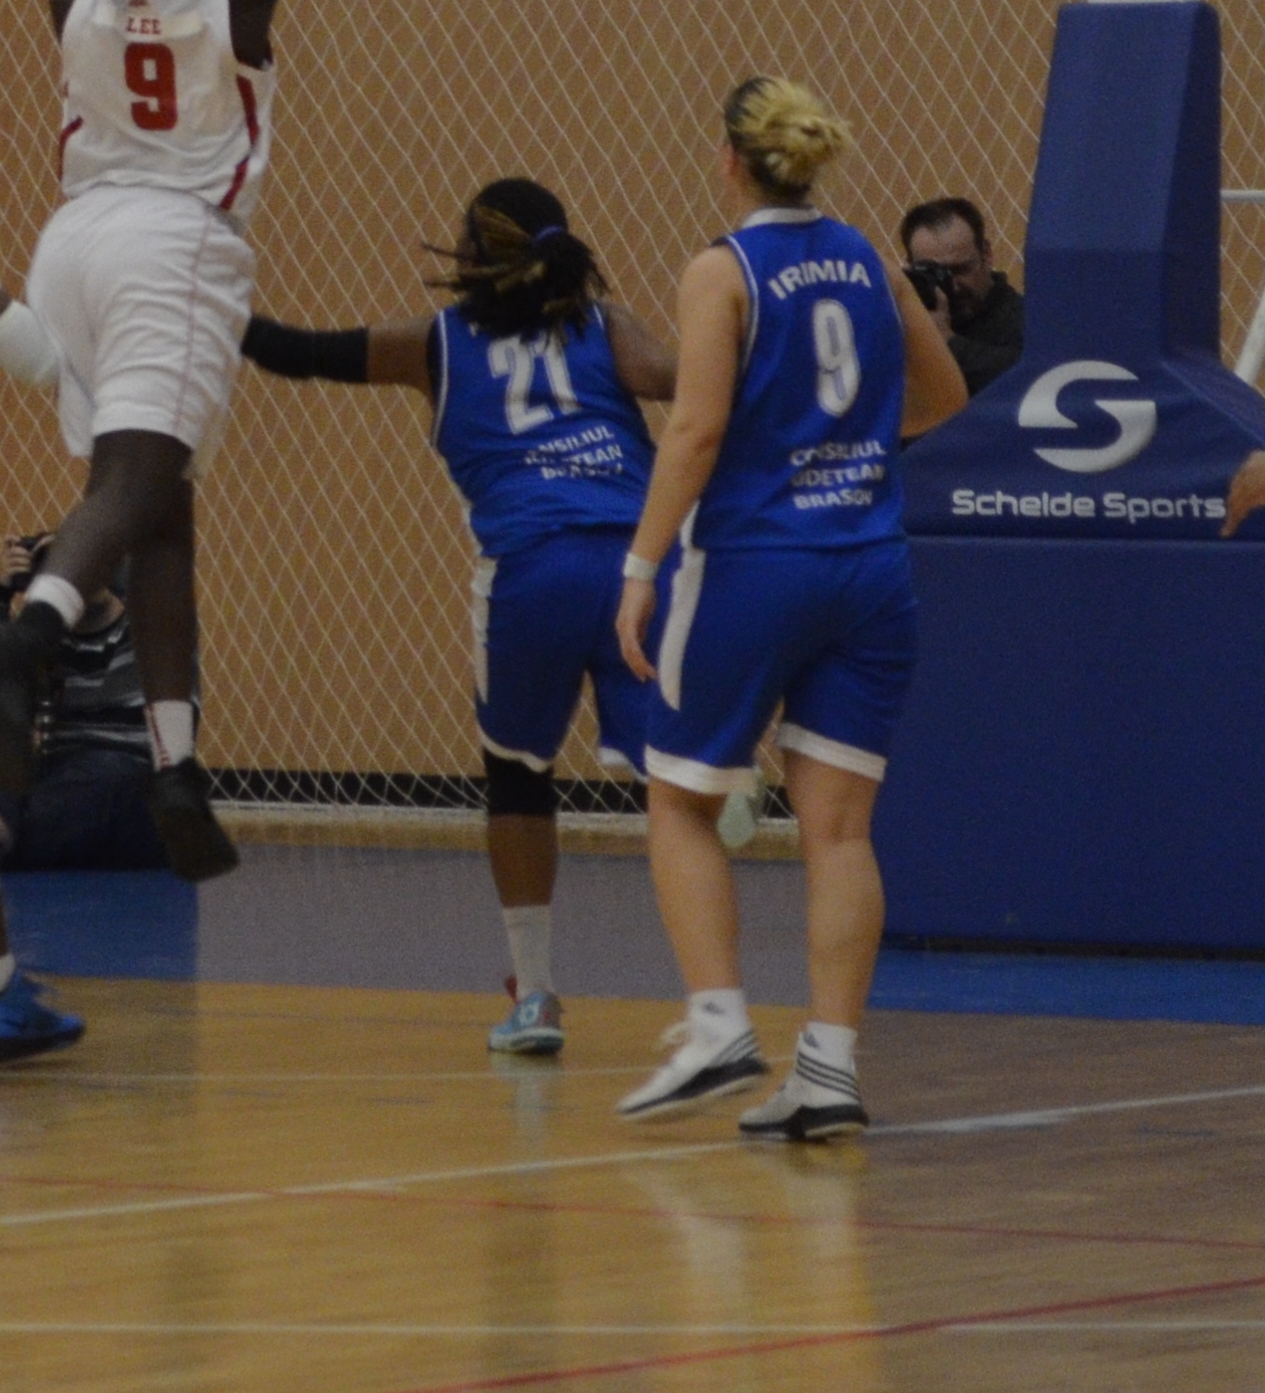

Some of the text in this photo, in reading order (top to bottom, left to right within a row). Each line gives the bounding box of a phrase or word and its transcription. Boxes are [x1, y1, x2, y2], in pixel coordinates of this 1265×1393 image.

[125, 16, 162, 36] LEE
[124, 42, 178, 131] 9
[768, 260, 872, 300] IRIMIA
[488, 320, 582, 435] 21
[813, 298, 861, 417] 9
[952, 489, 1227, 525] Schelde Sports
